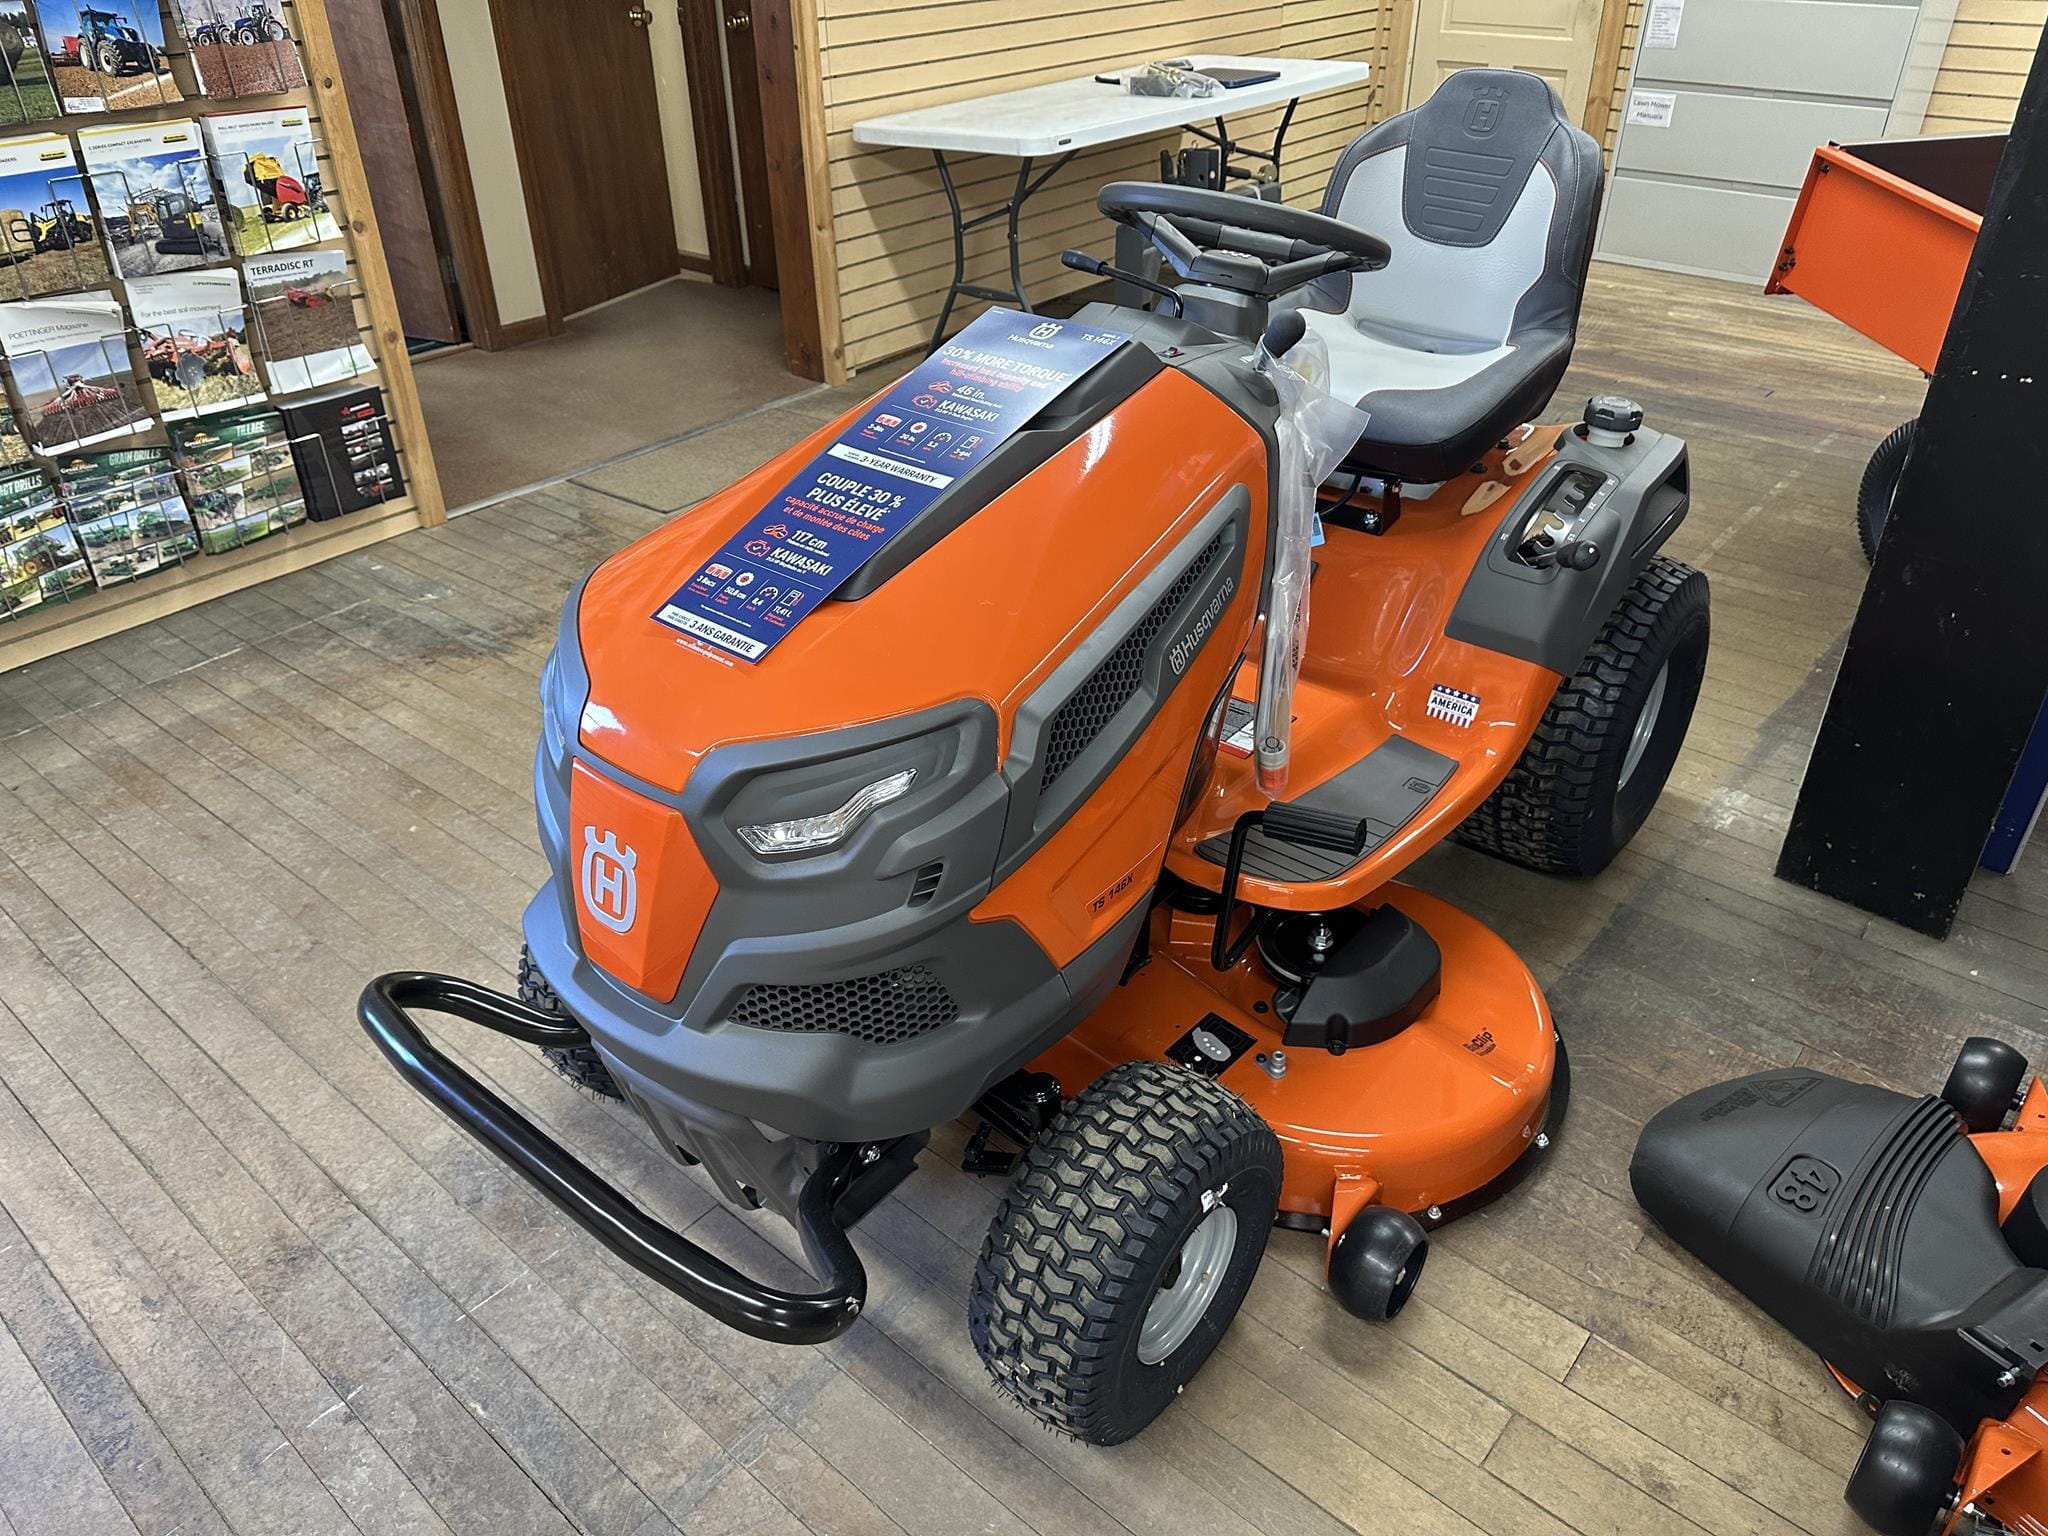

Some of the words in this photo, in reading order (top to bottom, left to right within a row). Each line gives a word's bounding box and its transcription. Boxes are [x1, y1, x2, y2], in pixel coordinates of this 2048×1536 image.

[1636, 111, 1663, 120] Manuals
[1650, 101, 1672, 109] Mower
[250, 261, 301, 276] TERRADISC
[303, 259, 314, 268] RT
[1008, 334, 1055, 350] Husqvarna
[1081, 333, 1095, 342] TS
[943, 346, 976, 360] 30%
[975, 353, 1015, 370] MORE
[957, 385, 973, 396] 46
[938, 400, 1000, 422] KAWASAKI
[859, 456, 892, 471] 3-YEAR
[890, 462, 937, 483] WARRANTY
[14, 475, 43, 493] DRILLS
[817, 472, 872, 498] COUPLE
[868, 490, 892, 504] 30
[888, 495, 906, 509] %
[806, 487, 846, 507] PLUS
[785, 495, 820, 512] capacité
[818, 505, 847, 521] accrue
[845, 515, 857, 524] de
[856, 518, 885, 534] charge
[793, 509, 805, 518] de
[803, 512, 835, 529] montée
[832, 523, 847, 534] des
[847, 528, 871, 541] côtes
[791, 530, 813, 541] 117
[808, 538, 828, 550] cm
[770, 547, 834, 576] KAWASAKI
[1182, 576, 1234, 659] Husqvarna
[689, 620, 698, 628] 3
[696, 623, 714, 636] ANS
[713, 630, 755, 653] GARANTIE
[1431, 696, 1473, 717] AMERICA
[1092, 896, 1106, 912] TS
[1108, 872, 1134, 900] 146X
[1776, 1169, 1829, 1212] 48
